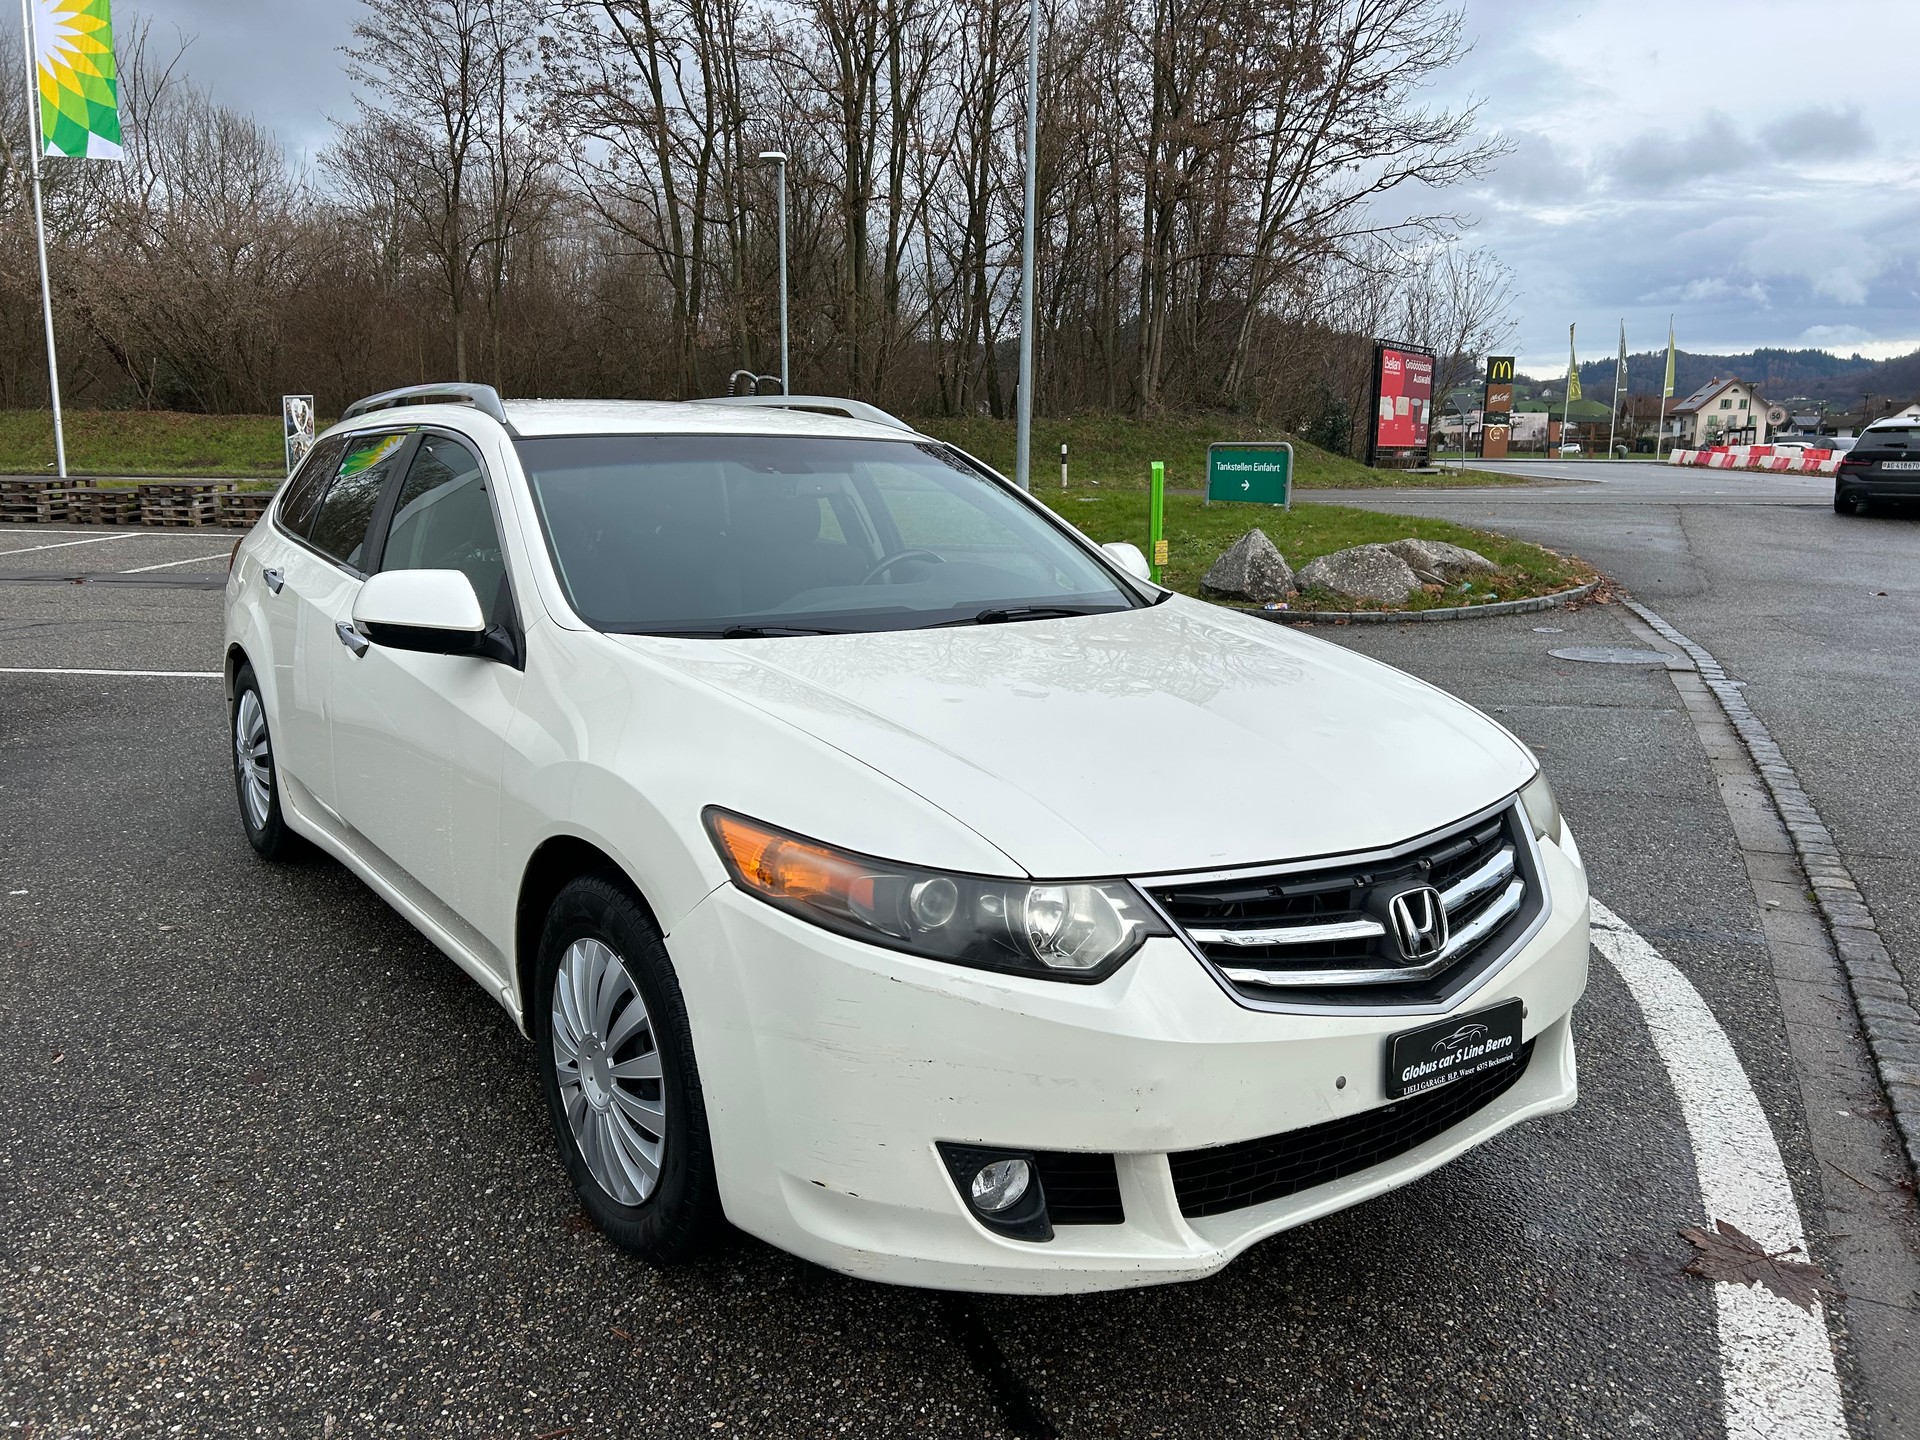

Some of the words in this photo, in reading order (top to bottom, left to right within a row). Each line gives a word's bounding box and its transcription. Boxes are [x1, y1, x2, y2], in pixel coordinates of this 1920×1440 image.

[1771, 412, 1781, 420] 50
[1216, 462, 1252, 472] Tankstellen
[1253, 462, 1280, 472] Einfahrt
[1402, 1060, 1437, 1081] Globus
[1438, 1054, 1455, 1068] car
[1455, 1049, 1463, 1063] S
[1463, 1045, 1484, 1060] Line
[1485, 1035, 1512, 1053] Berro
[1420, 1076, 1446, 1090] GARAGE
[1459, 1067, 1475, 1077] Waser
[1476, 1061, 1488, 1072] 6375
